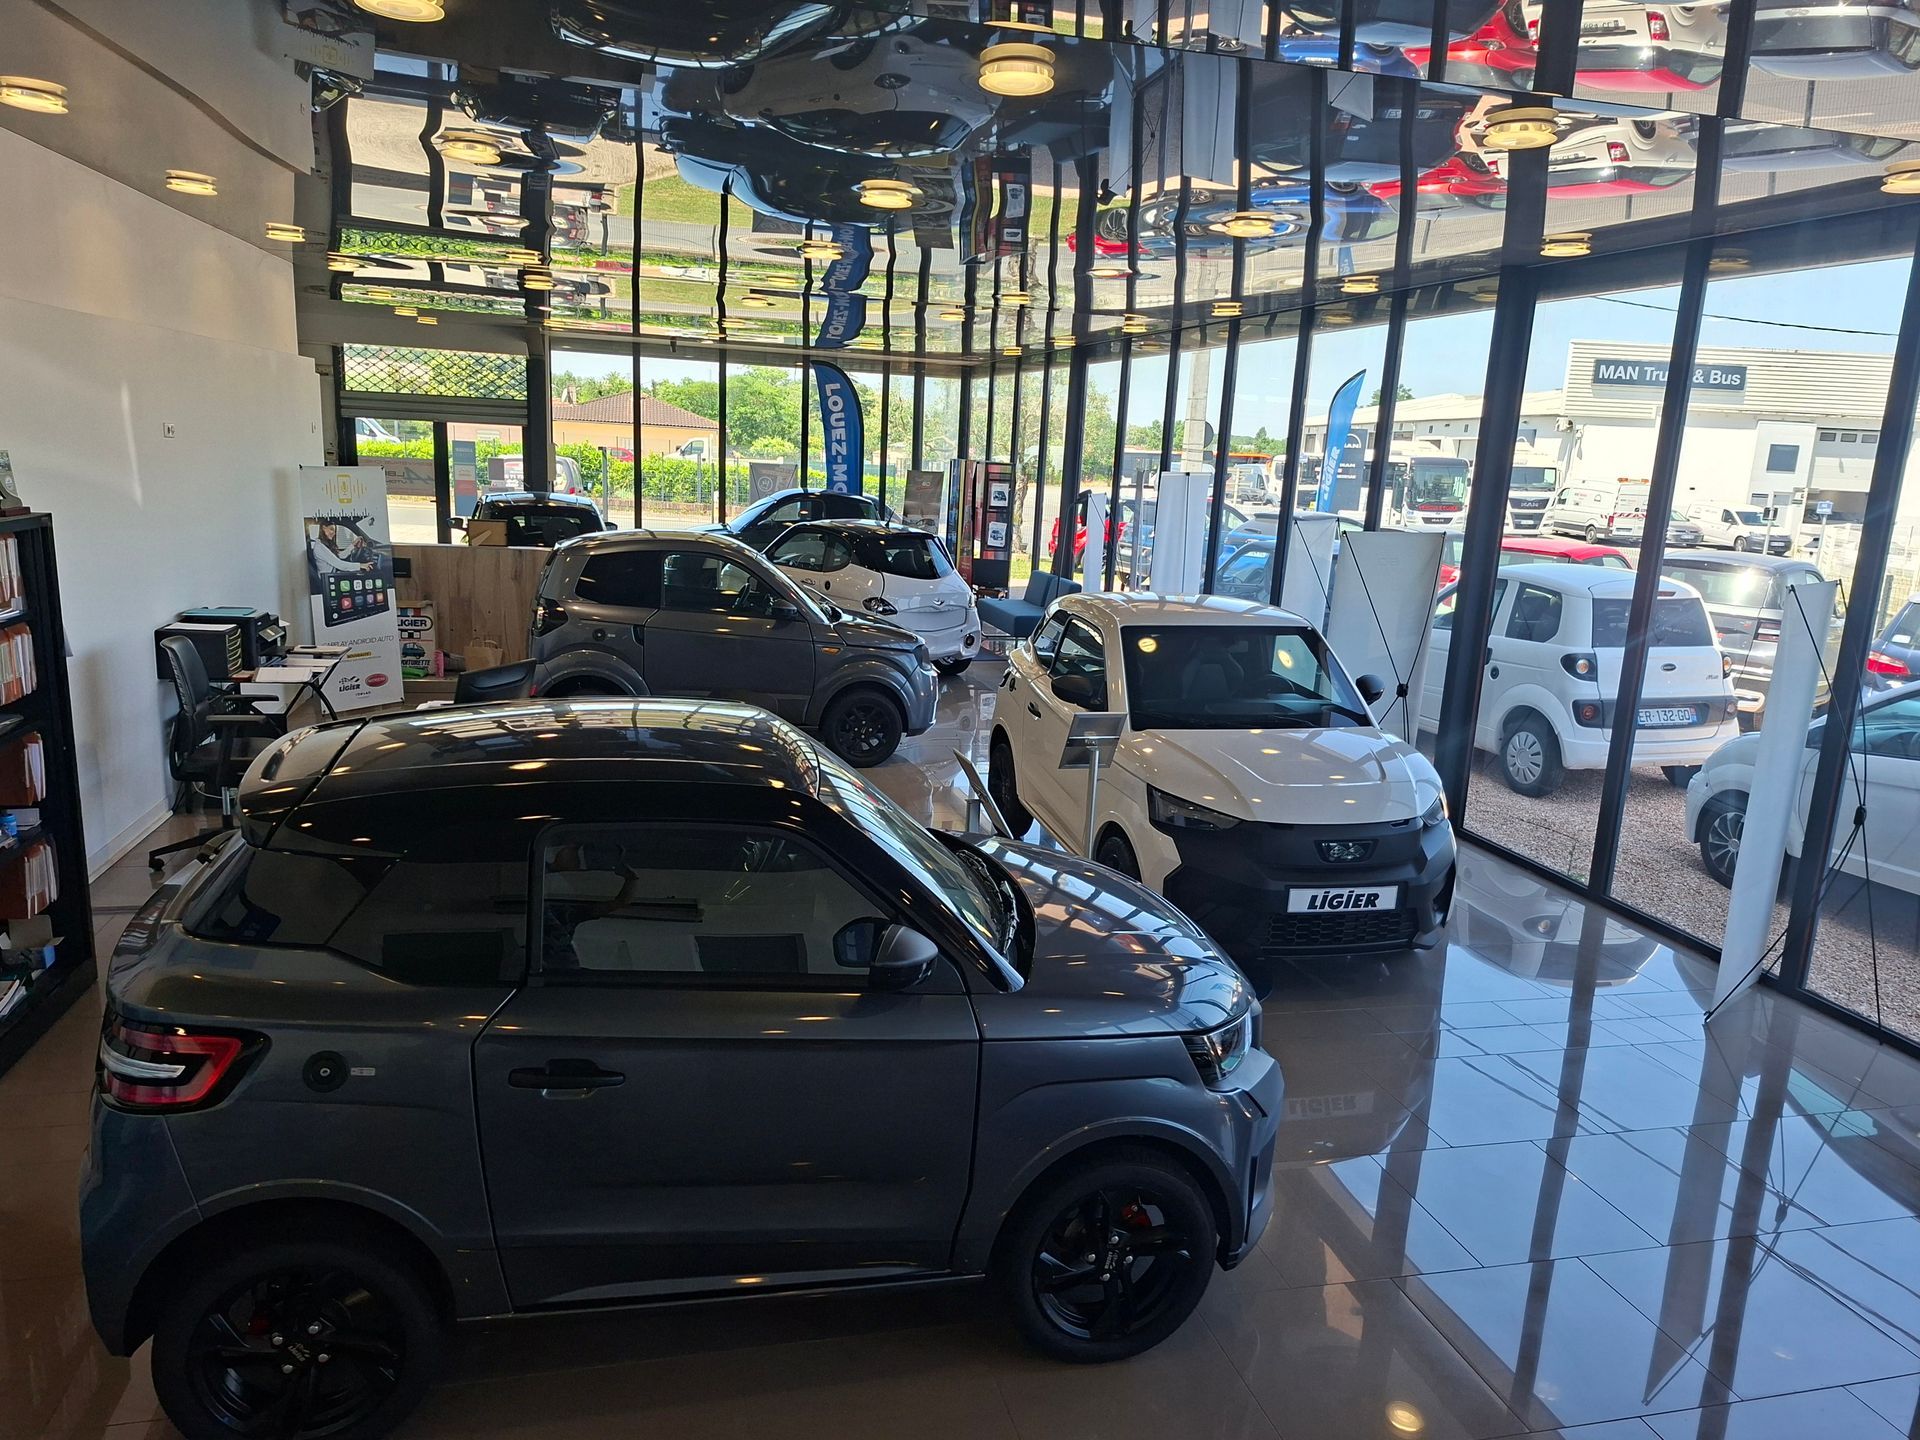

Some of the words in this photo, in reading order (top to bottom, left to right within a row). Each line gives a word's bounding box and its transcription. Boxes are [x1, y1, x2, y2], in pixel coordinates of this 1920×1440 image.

[1599, 365, 1639, 381] MAN
[1644, 366, 1669, 382] Tru
[1693, 369, 1704, 384] &
[1709, 370, 1741, 386] Bus
